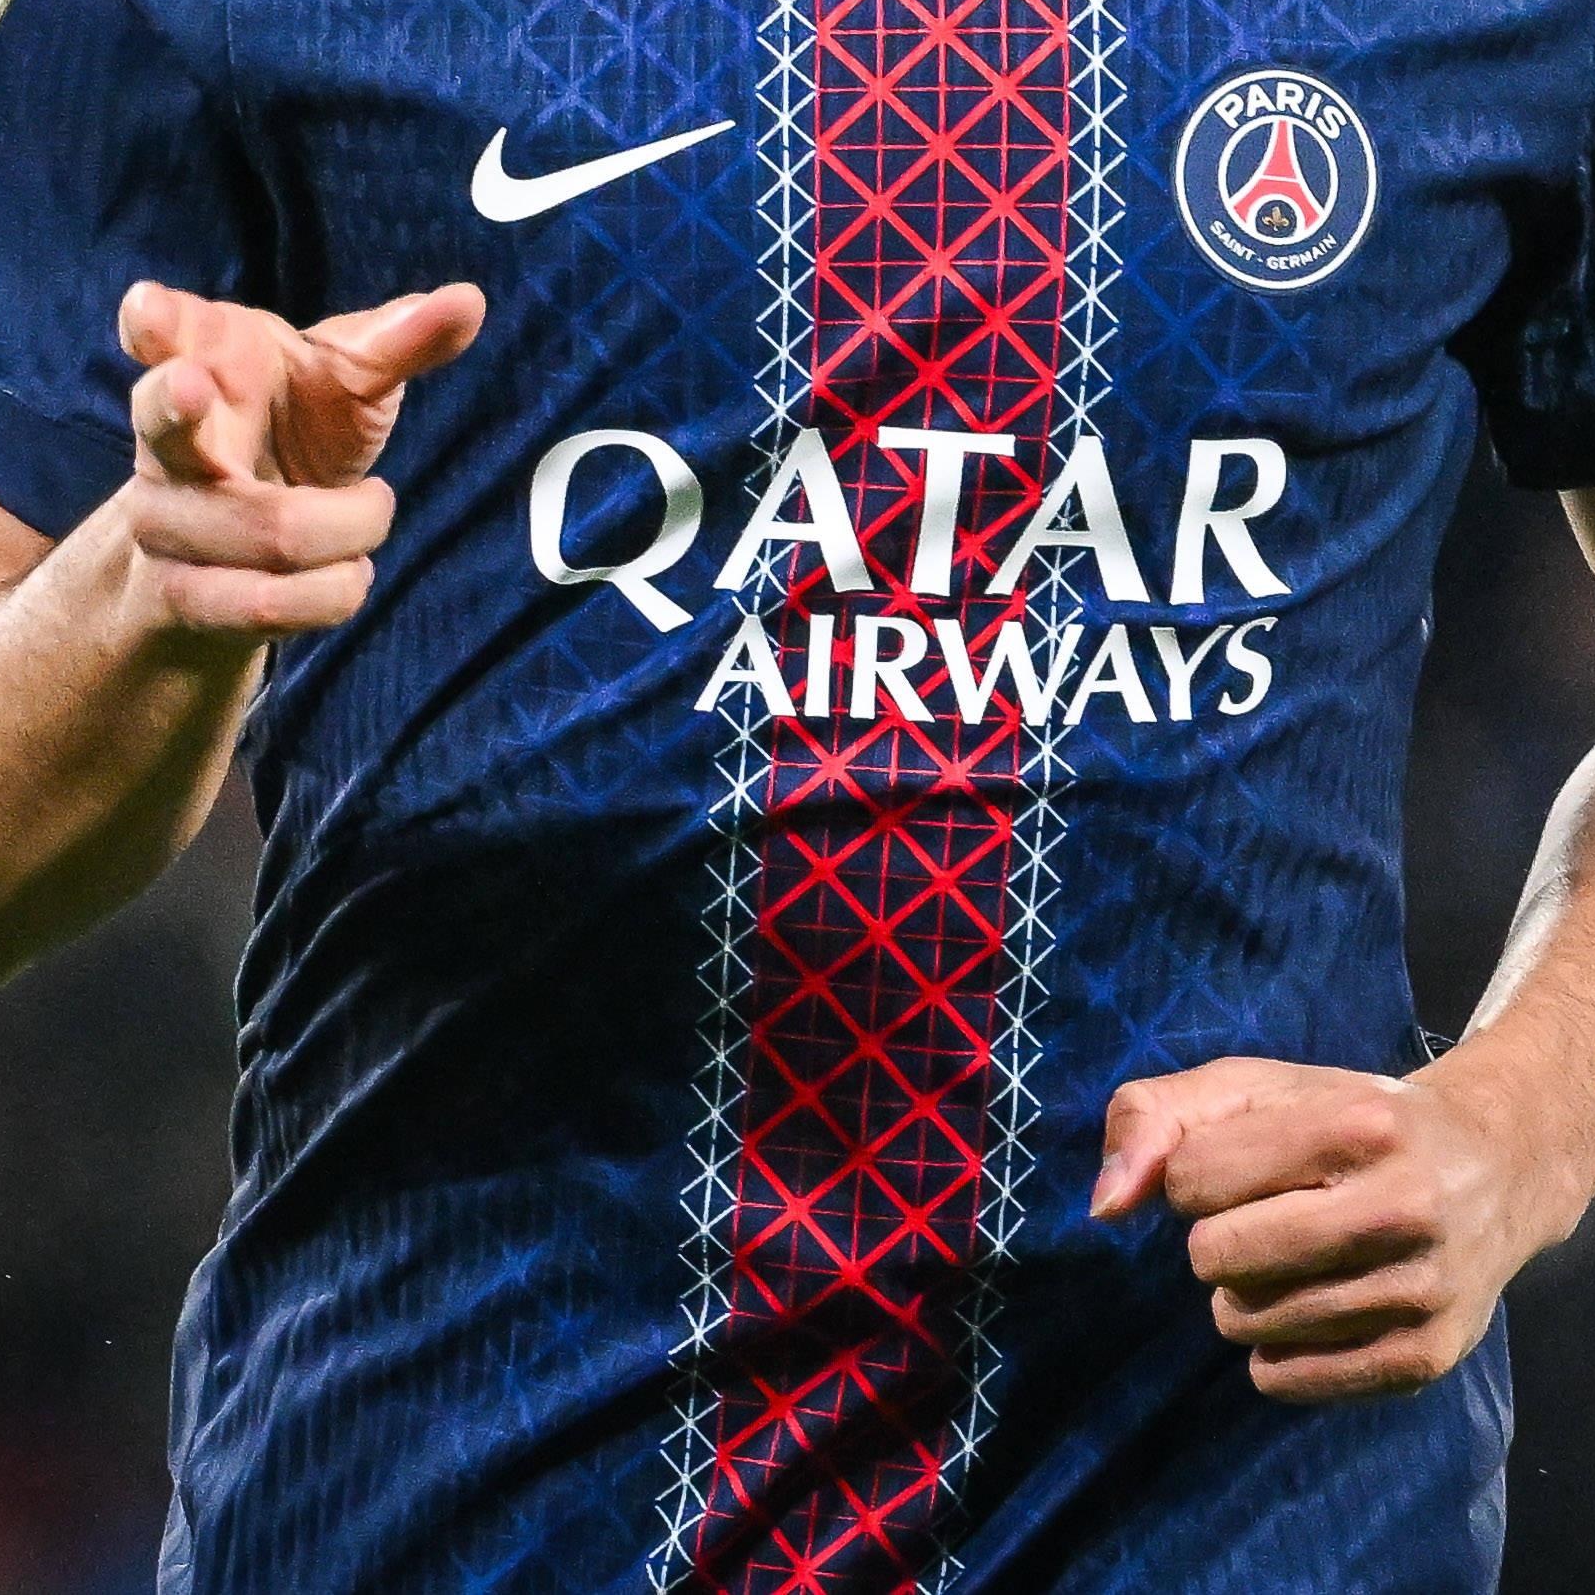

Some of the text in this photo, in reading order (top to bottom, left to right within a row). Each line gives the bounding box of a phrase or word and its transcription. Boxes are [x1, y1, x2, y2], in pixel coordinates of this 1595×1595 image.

[1214, 81, 1348, 140] PARIS
[528, 426, 1293, 633] QATAR
[693, 613, 1280, 726] AIRWAYS
